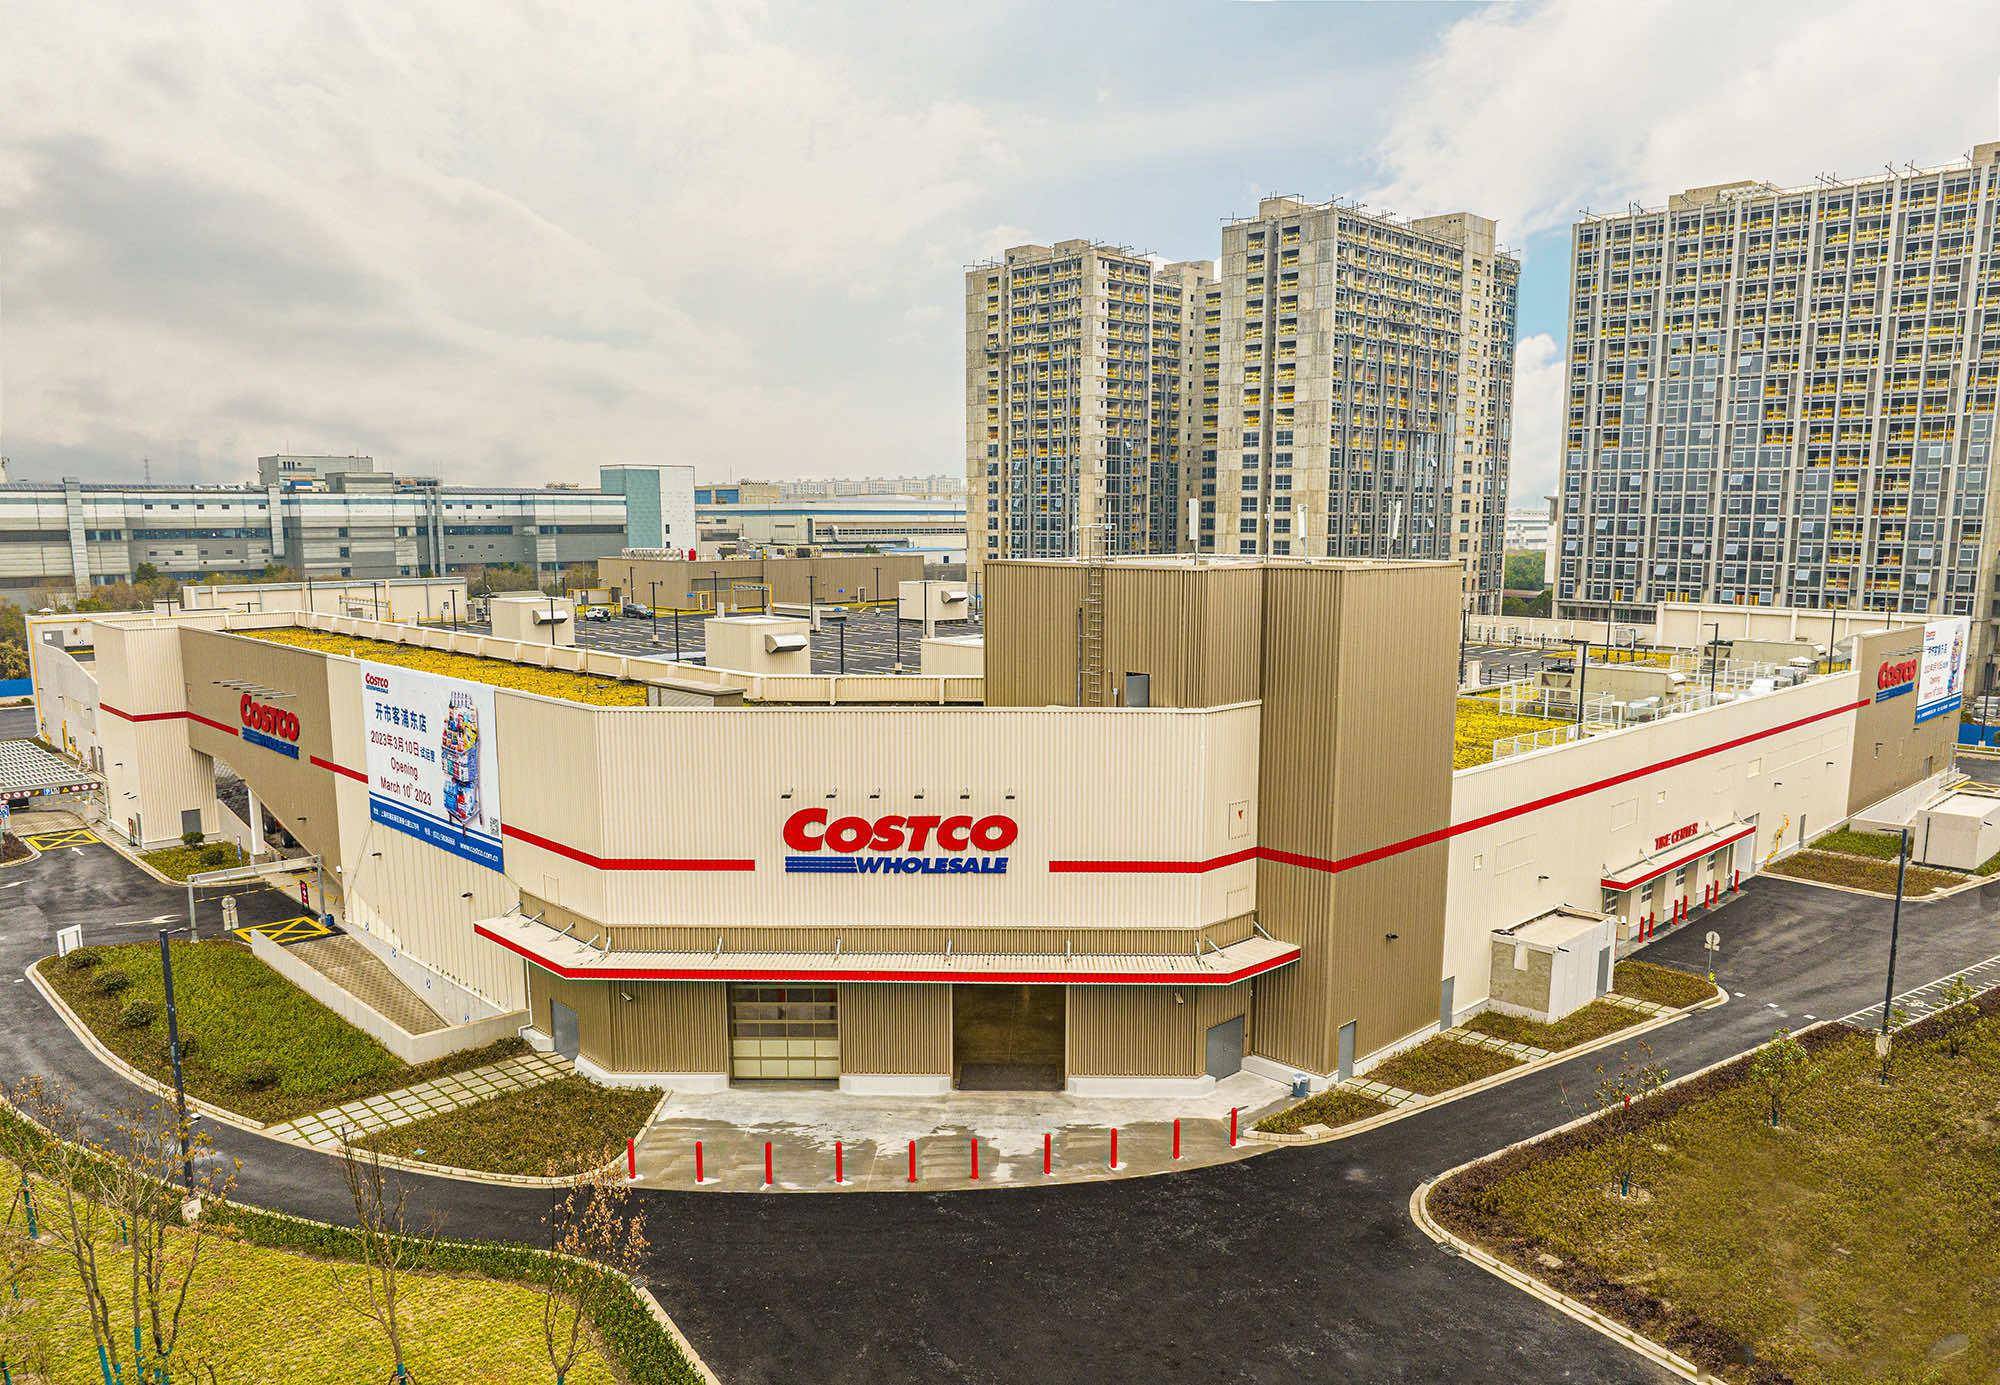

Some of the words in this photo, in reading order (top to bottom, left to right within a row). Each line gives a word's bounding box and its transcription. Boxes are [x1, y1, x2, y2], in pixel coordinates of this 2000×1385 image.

[365, 673, 389, 689] COSTCO
[1878, 659, 1918, 690] COSTCO
[240, 693, 300, 742] COSTCO
[375, 702, 428, 734] 开市客浦东店
[391, 756, 419, 781] Opening
[381, 776, 401, 796] March
[415, 788, 432, 806] 2023
[783, 807, 1019, 854] COSTCO
[855, 857, 1009, 874] WHOLESALE
